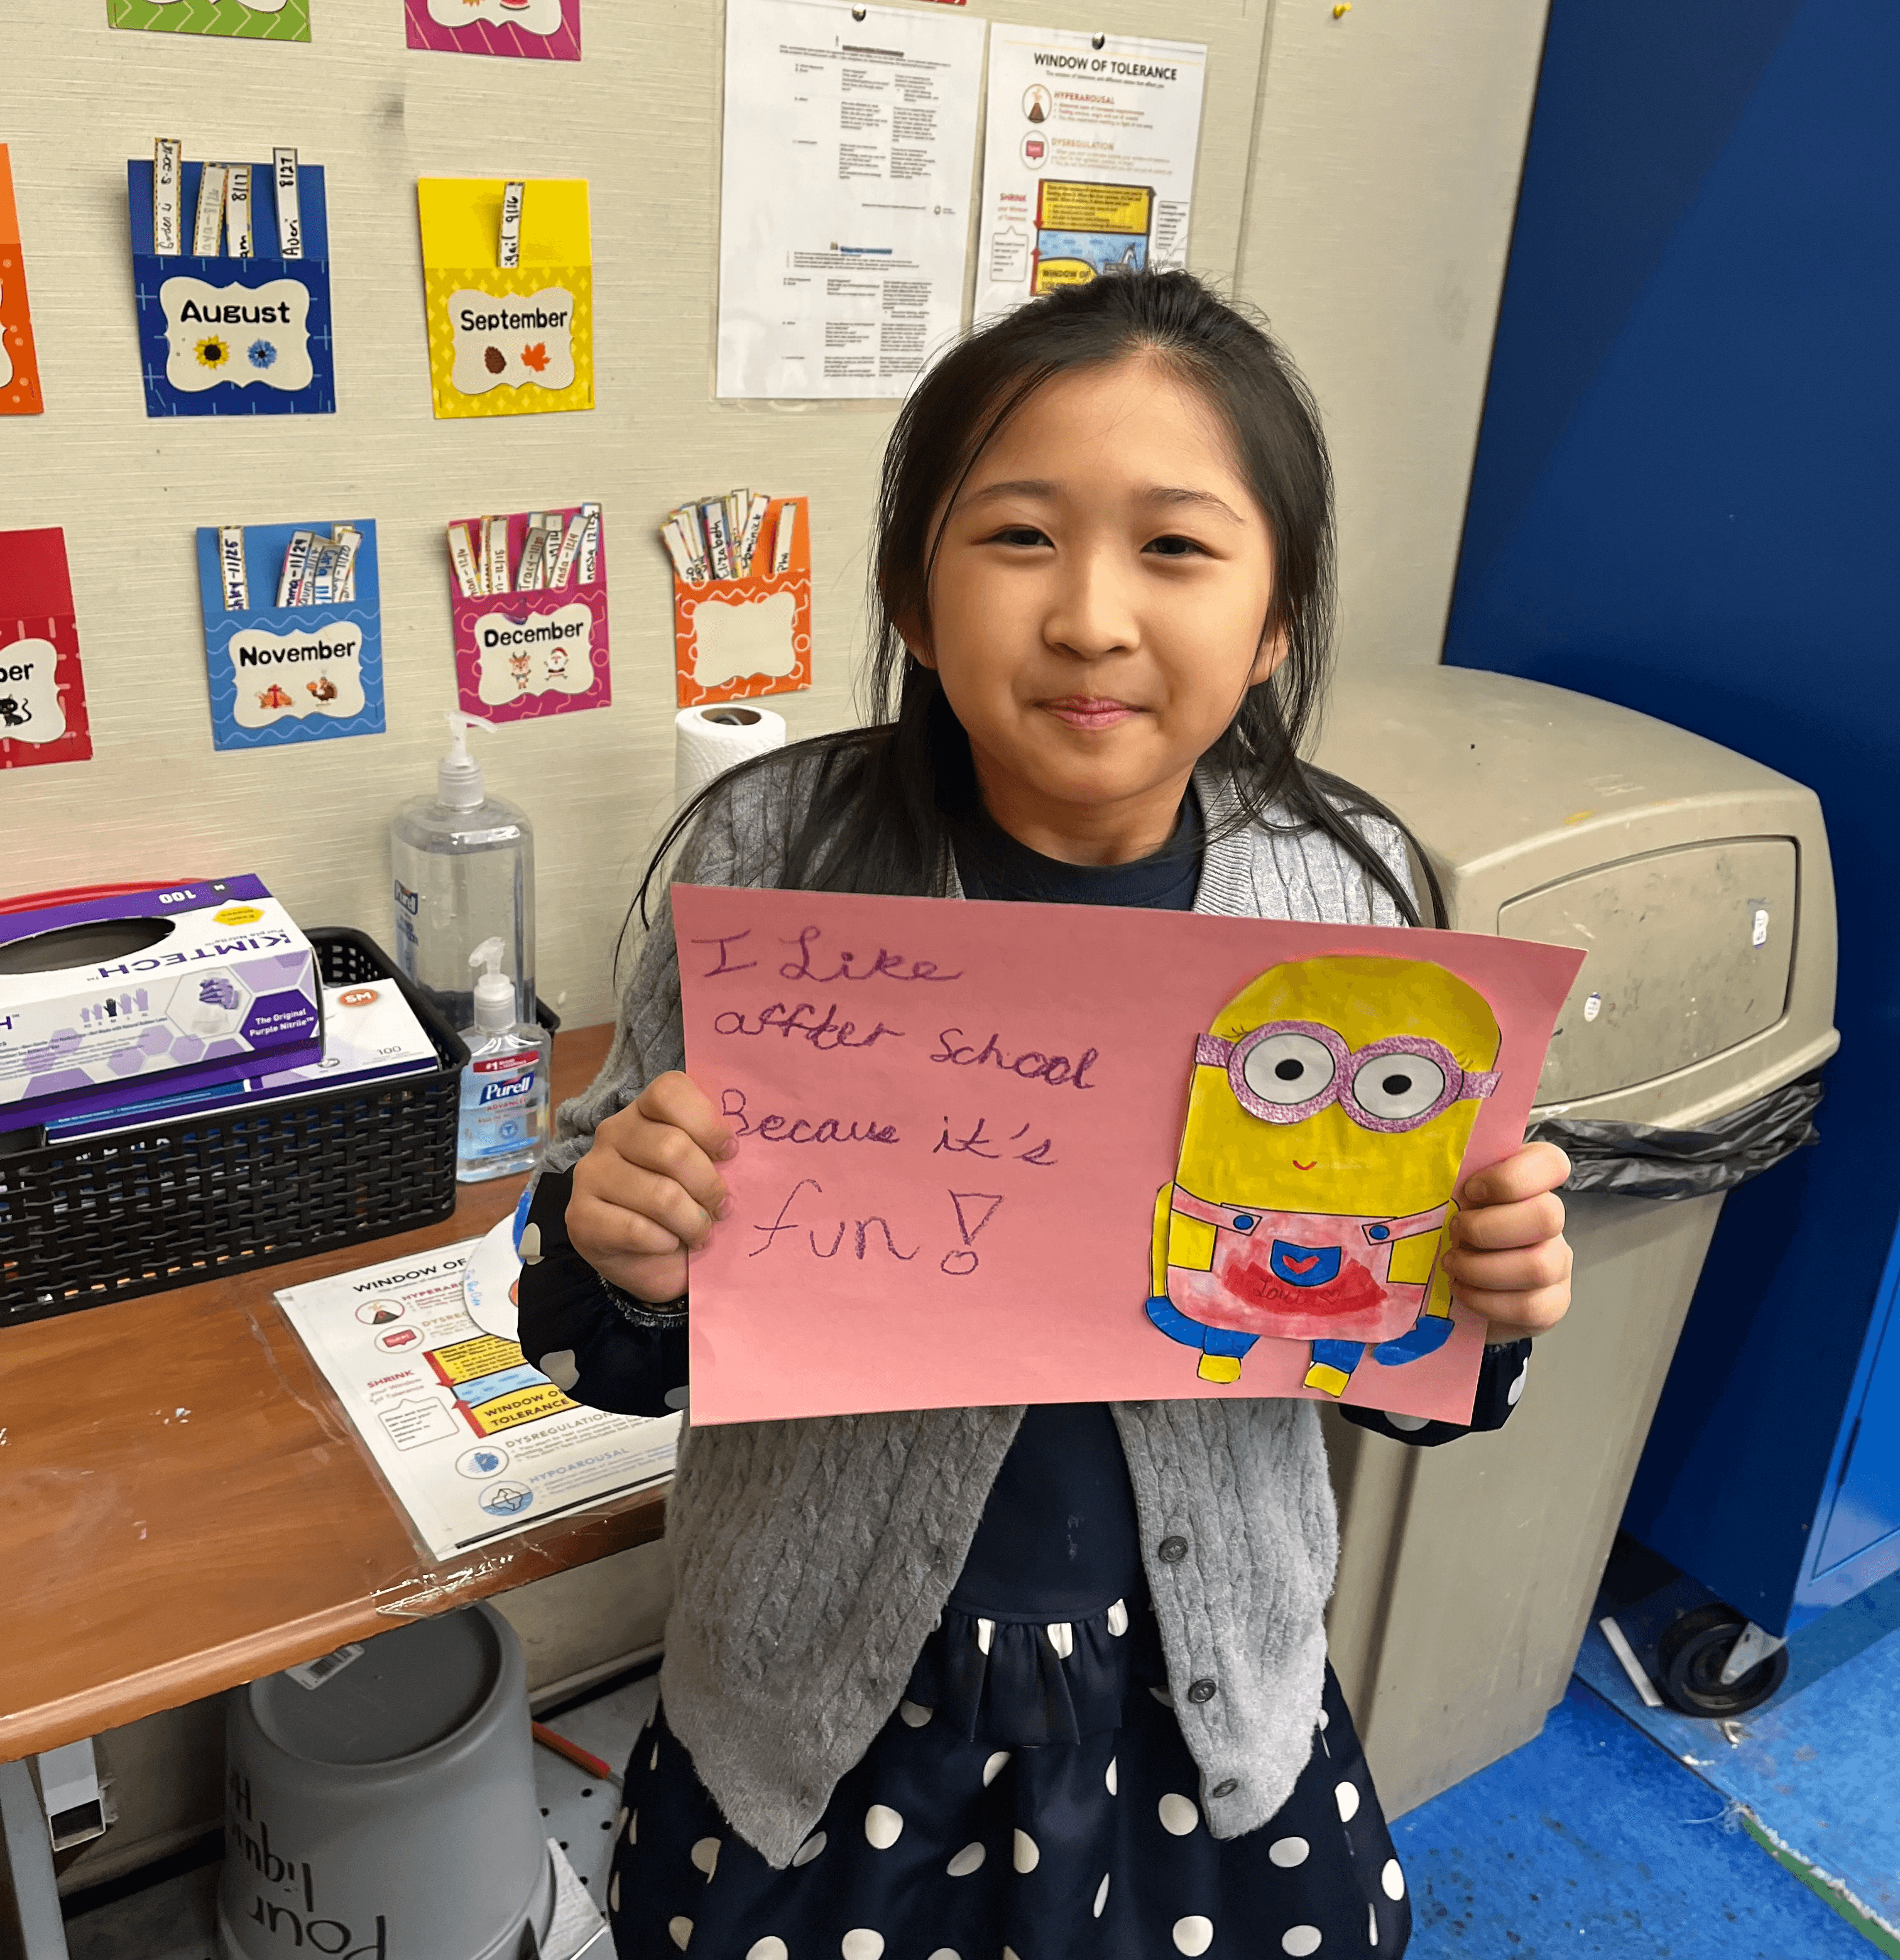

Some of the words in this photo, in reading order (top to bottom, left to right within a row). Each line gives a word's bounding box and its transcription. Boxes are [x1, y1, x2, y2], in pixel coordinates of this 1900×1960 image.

[1034, 52, 1088, 70] WINDOW
[1091, 59, 1107, 72] OF
[1111, 61, 1177, 80] TOLERANCE
[180, 299, 291, 324] August
[461, 307, 567, 331] September
[484, 622, 584, 648] December
[239, 640, 356, 667] November
[158, 889, 197, 905] 100
[98, 933, 292, 979] KIMTECH
[690, 928, 758, 978] I
[344, 991, 372, 1003] SM
[254, 1015, 270, 1026] The
[273, 1008, 307, 1024] Original
[249, 1023, 279, 1037] Purple
[376, 1045, 402, 1055] 100
[485, 1061, 498, 1071] #1
[485, 1075, 531, 1100] Purell
[932, 1115, 1058, 1166] it's
[352, 1265, 438, 1293] WINDOW
[442, 1258, 469, 1270] OF
[367, 1369, 415, 1389] SHRINK
[484, 1392, 544, 1417] WINDOW
[490, 1398, 570, 1427] TOLERANCE
[530, 1447, 630, 1483] HYPOAROUSAL
